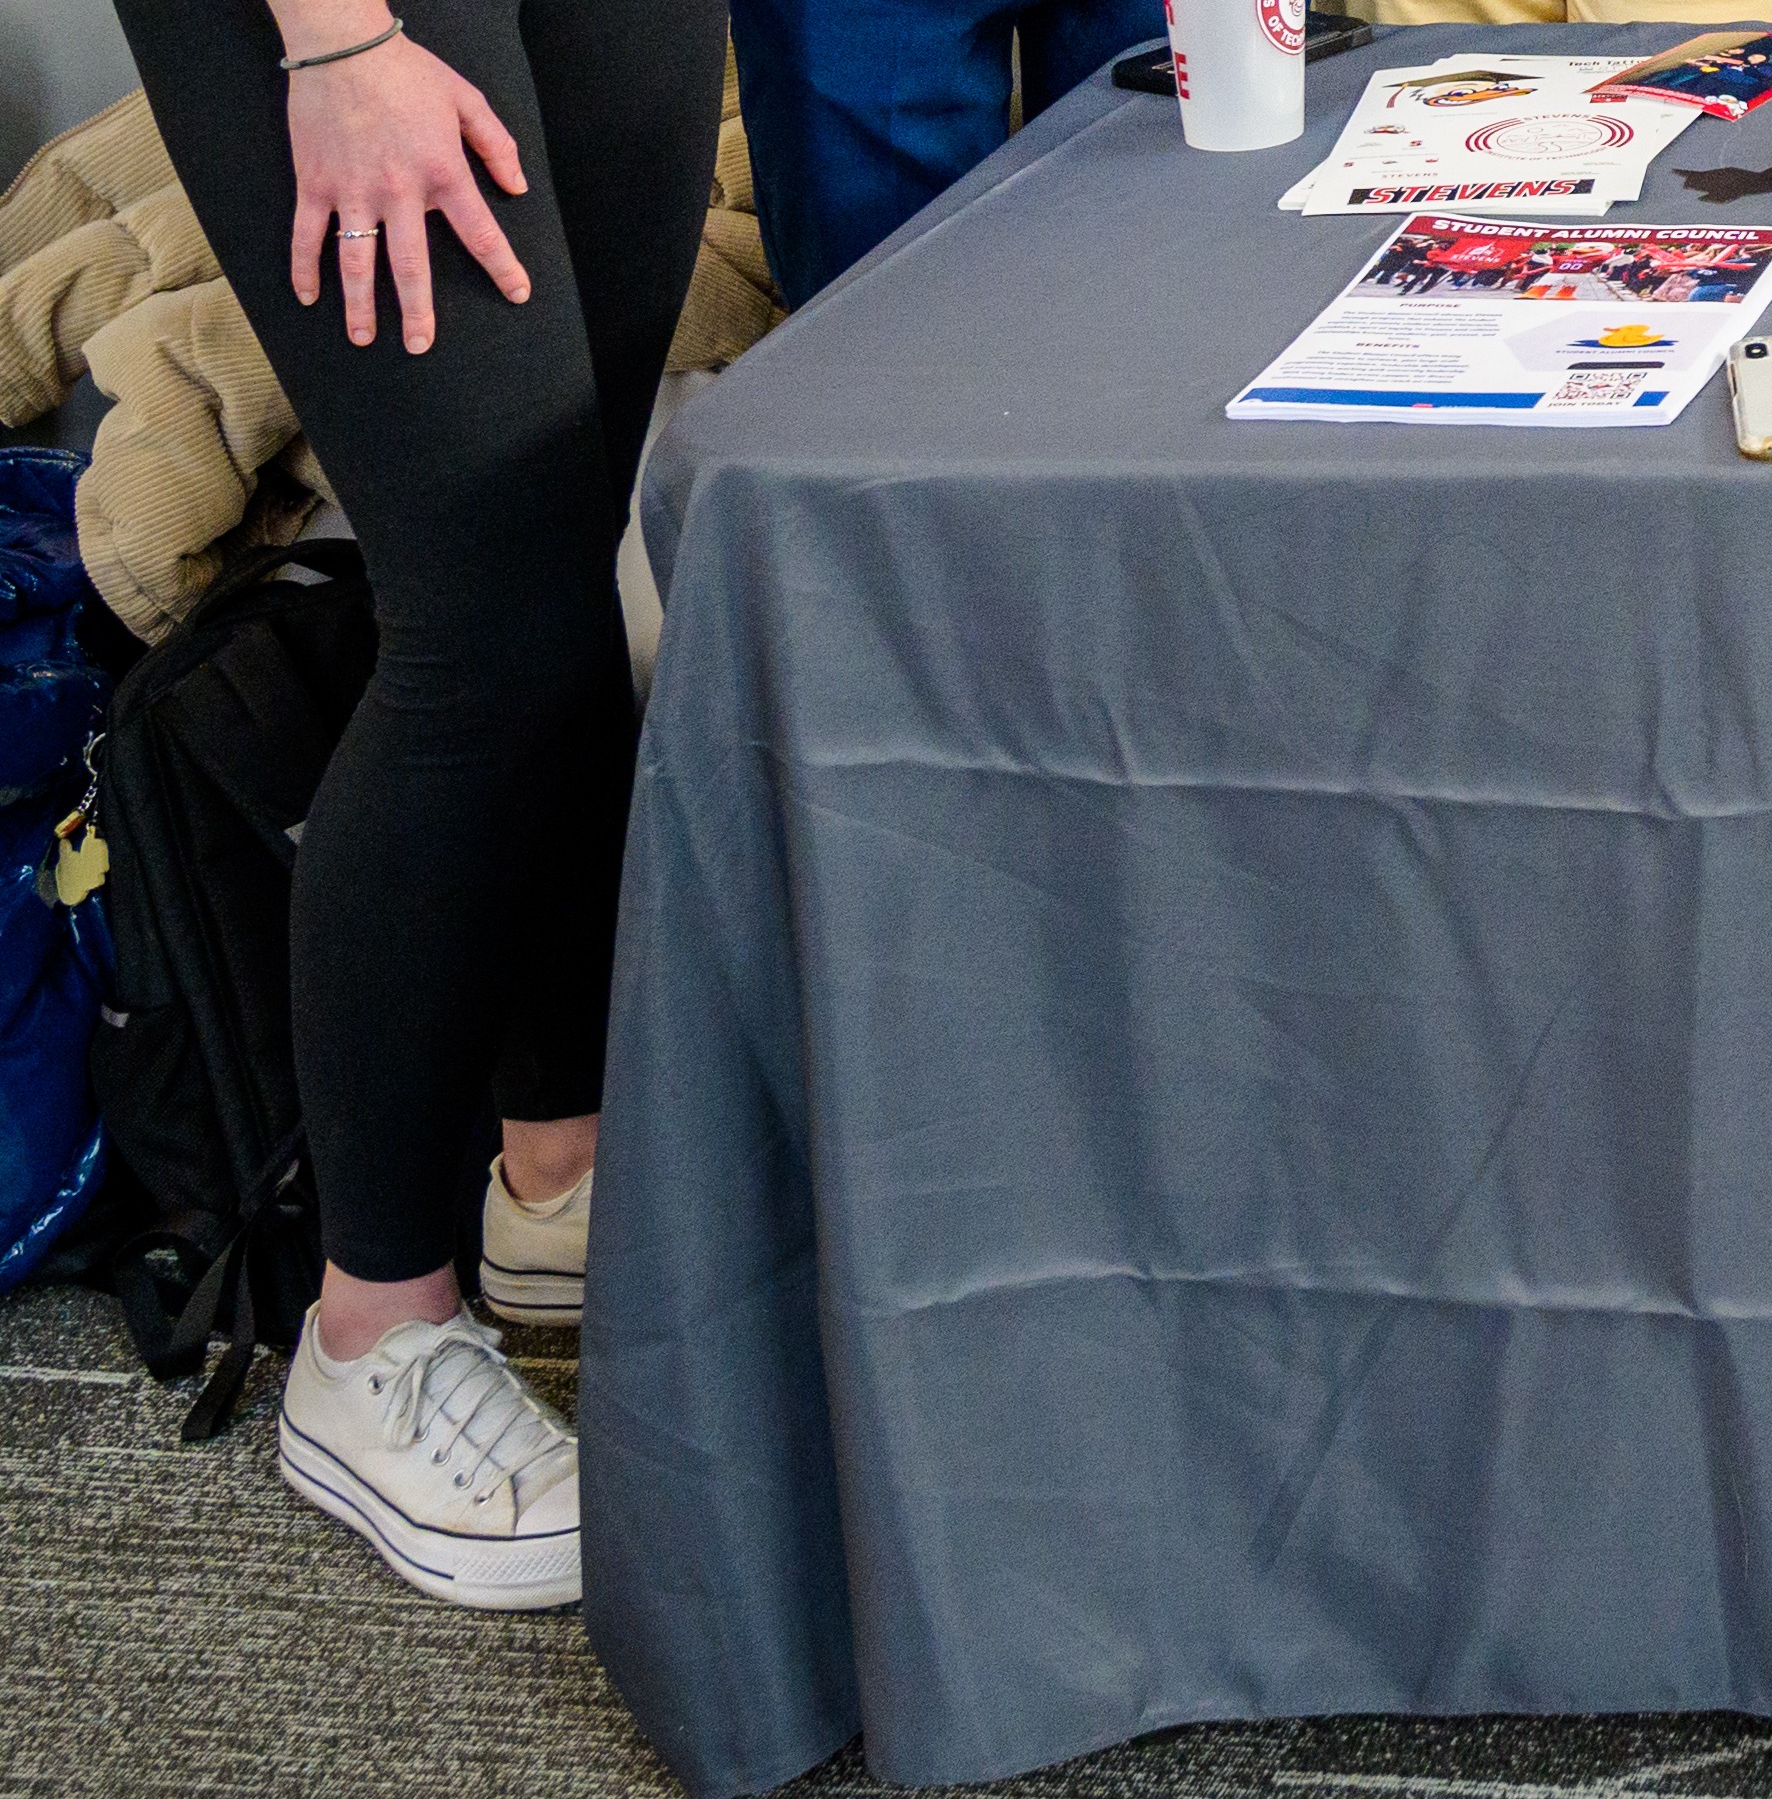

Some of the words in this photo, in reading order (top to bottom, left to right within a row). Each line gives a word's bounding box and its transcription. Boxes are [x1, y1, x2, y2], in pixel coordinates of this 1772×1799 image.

[1268, 15, 1284, 33] OF
[1364, 178, 1581, 205] STEVENS
[1432, 219, 1550, 239] STUDENT
[1551, 228, 1652, 240] ALUMNI
[1656, 230, 1759, 240] COUNCIL
